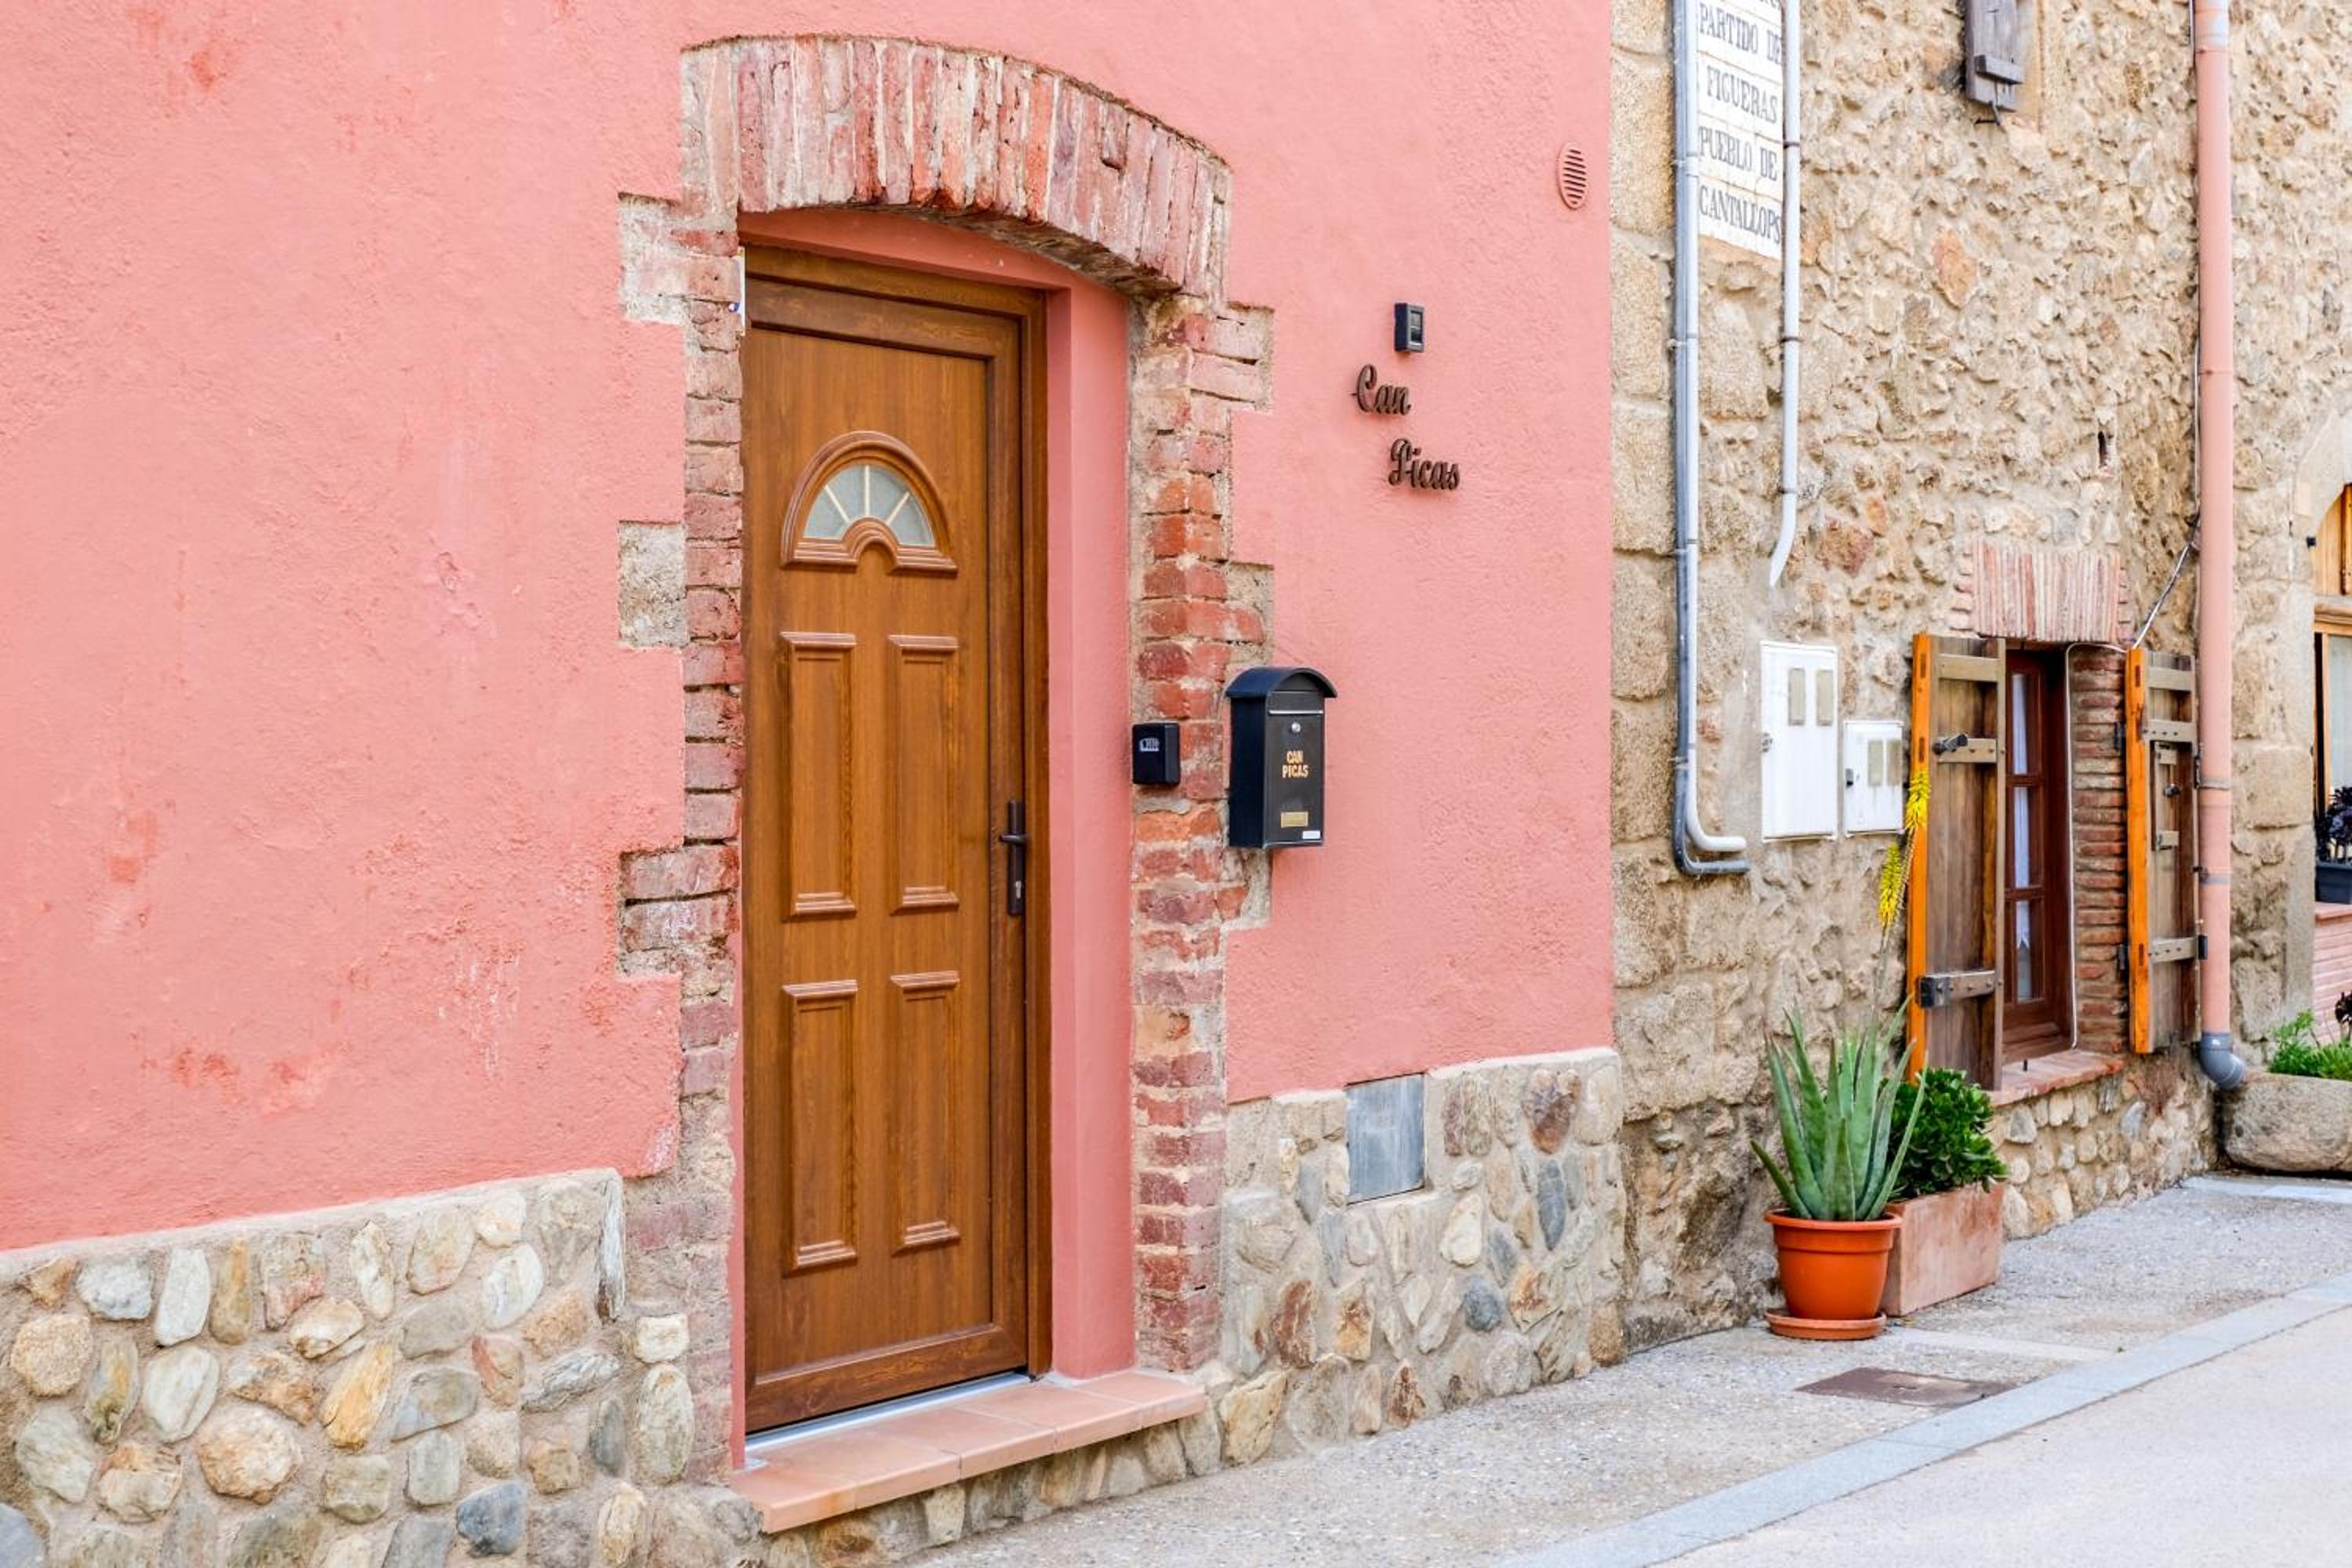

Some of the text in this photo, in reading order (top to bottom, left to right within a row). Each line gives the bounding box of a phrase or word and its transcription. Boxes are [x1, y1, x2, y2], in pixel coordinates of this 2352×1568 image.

[1699, 2, 1758, 54] PARTIDO
[1707, 65, 1777, 124] FIGUERAS
[1698, 125, 1777, 181] PUEBLO DE
[1699, 185, 1780, 244] CANTALLOPS
[1351, 364, 1411, 416] Can
[1388, 438, 1460, 491] Picas
[1282, 764, 1309, 779] PICAS
